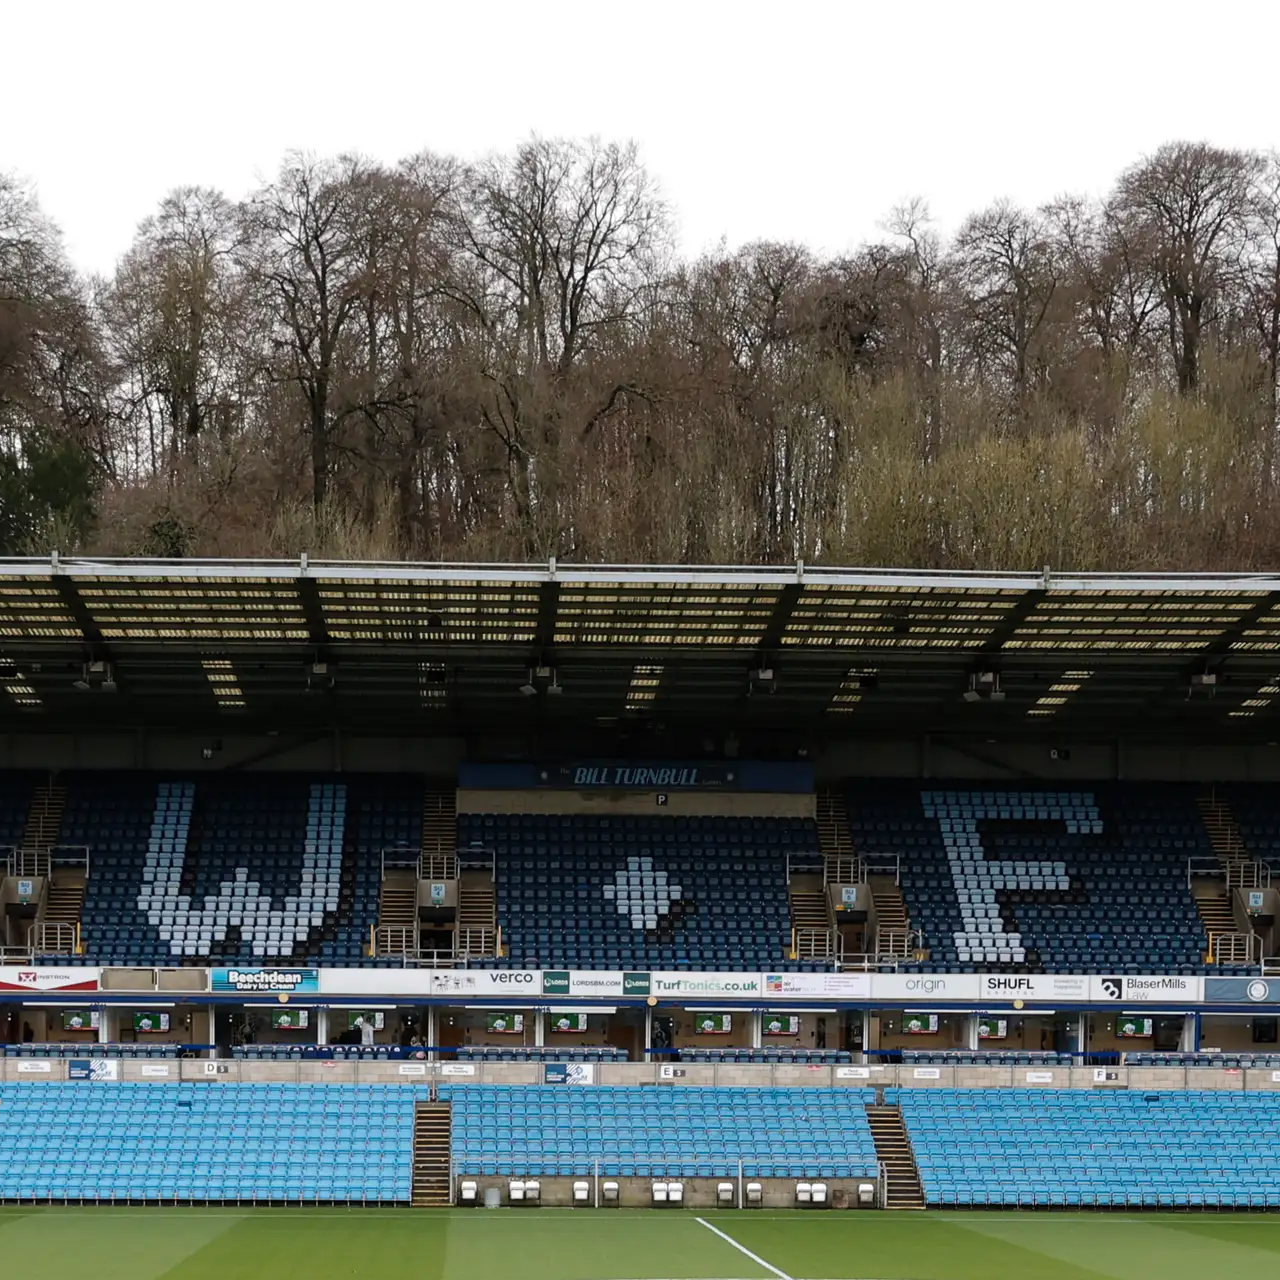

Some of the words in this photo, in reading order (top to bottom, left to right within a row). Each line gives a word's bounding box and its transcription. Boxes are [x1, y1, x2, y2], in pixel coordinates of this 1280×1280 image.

[574, 767, 609, 784] BILL
[614, 768, 698, 785] TURNBULL
[228, 970, 302, 983] Beechdean
[490, 972, 533, 983] verco
[655, 980, 758, 991] TurfTonics.co.uk
[906, 977, 946, 993] origin
[987, 978, 1035, 990] SHUFL
[1127, 978, 1186, 989] BlaserMills
[1127, 989, 1149, 1000] Law
[207, 1063, 214, 1072] D
